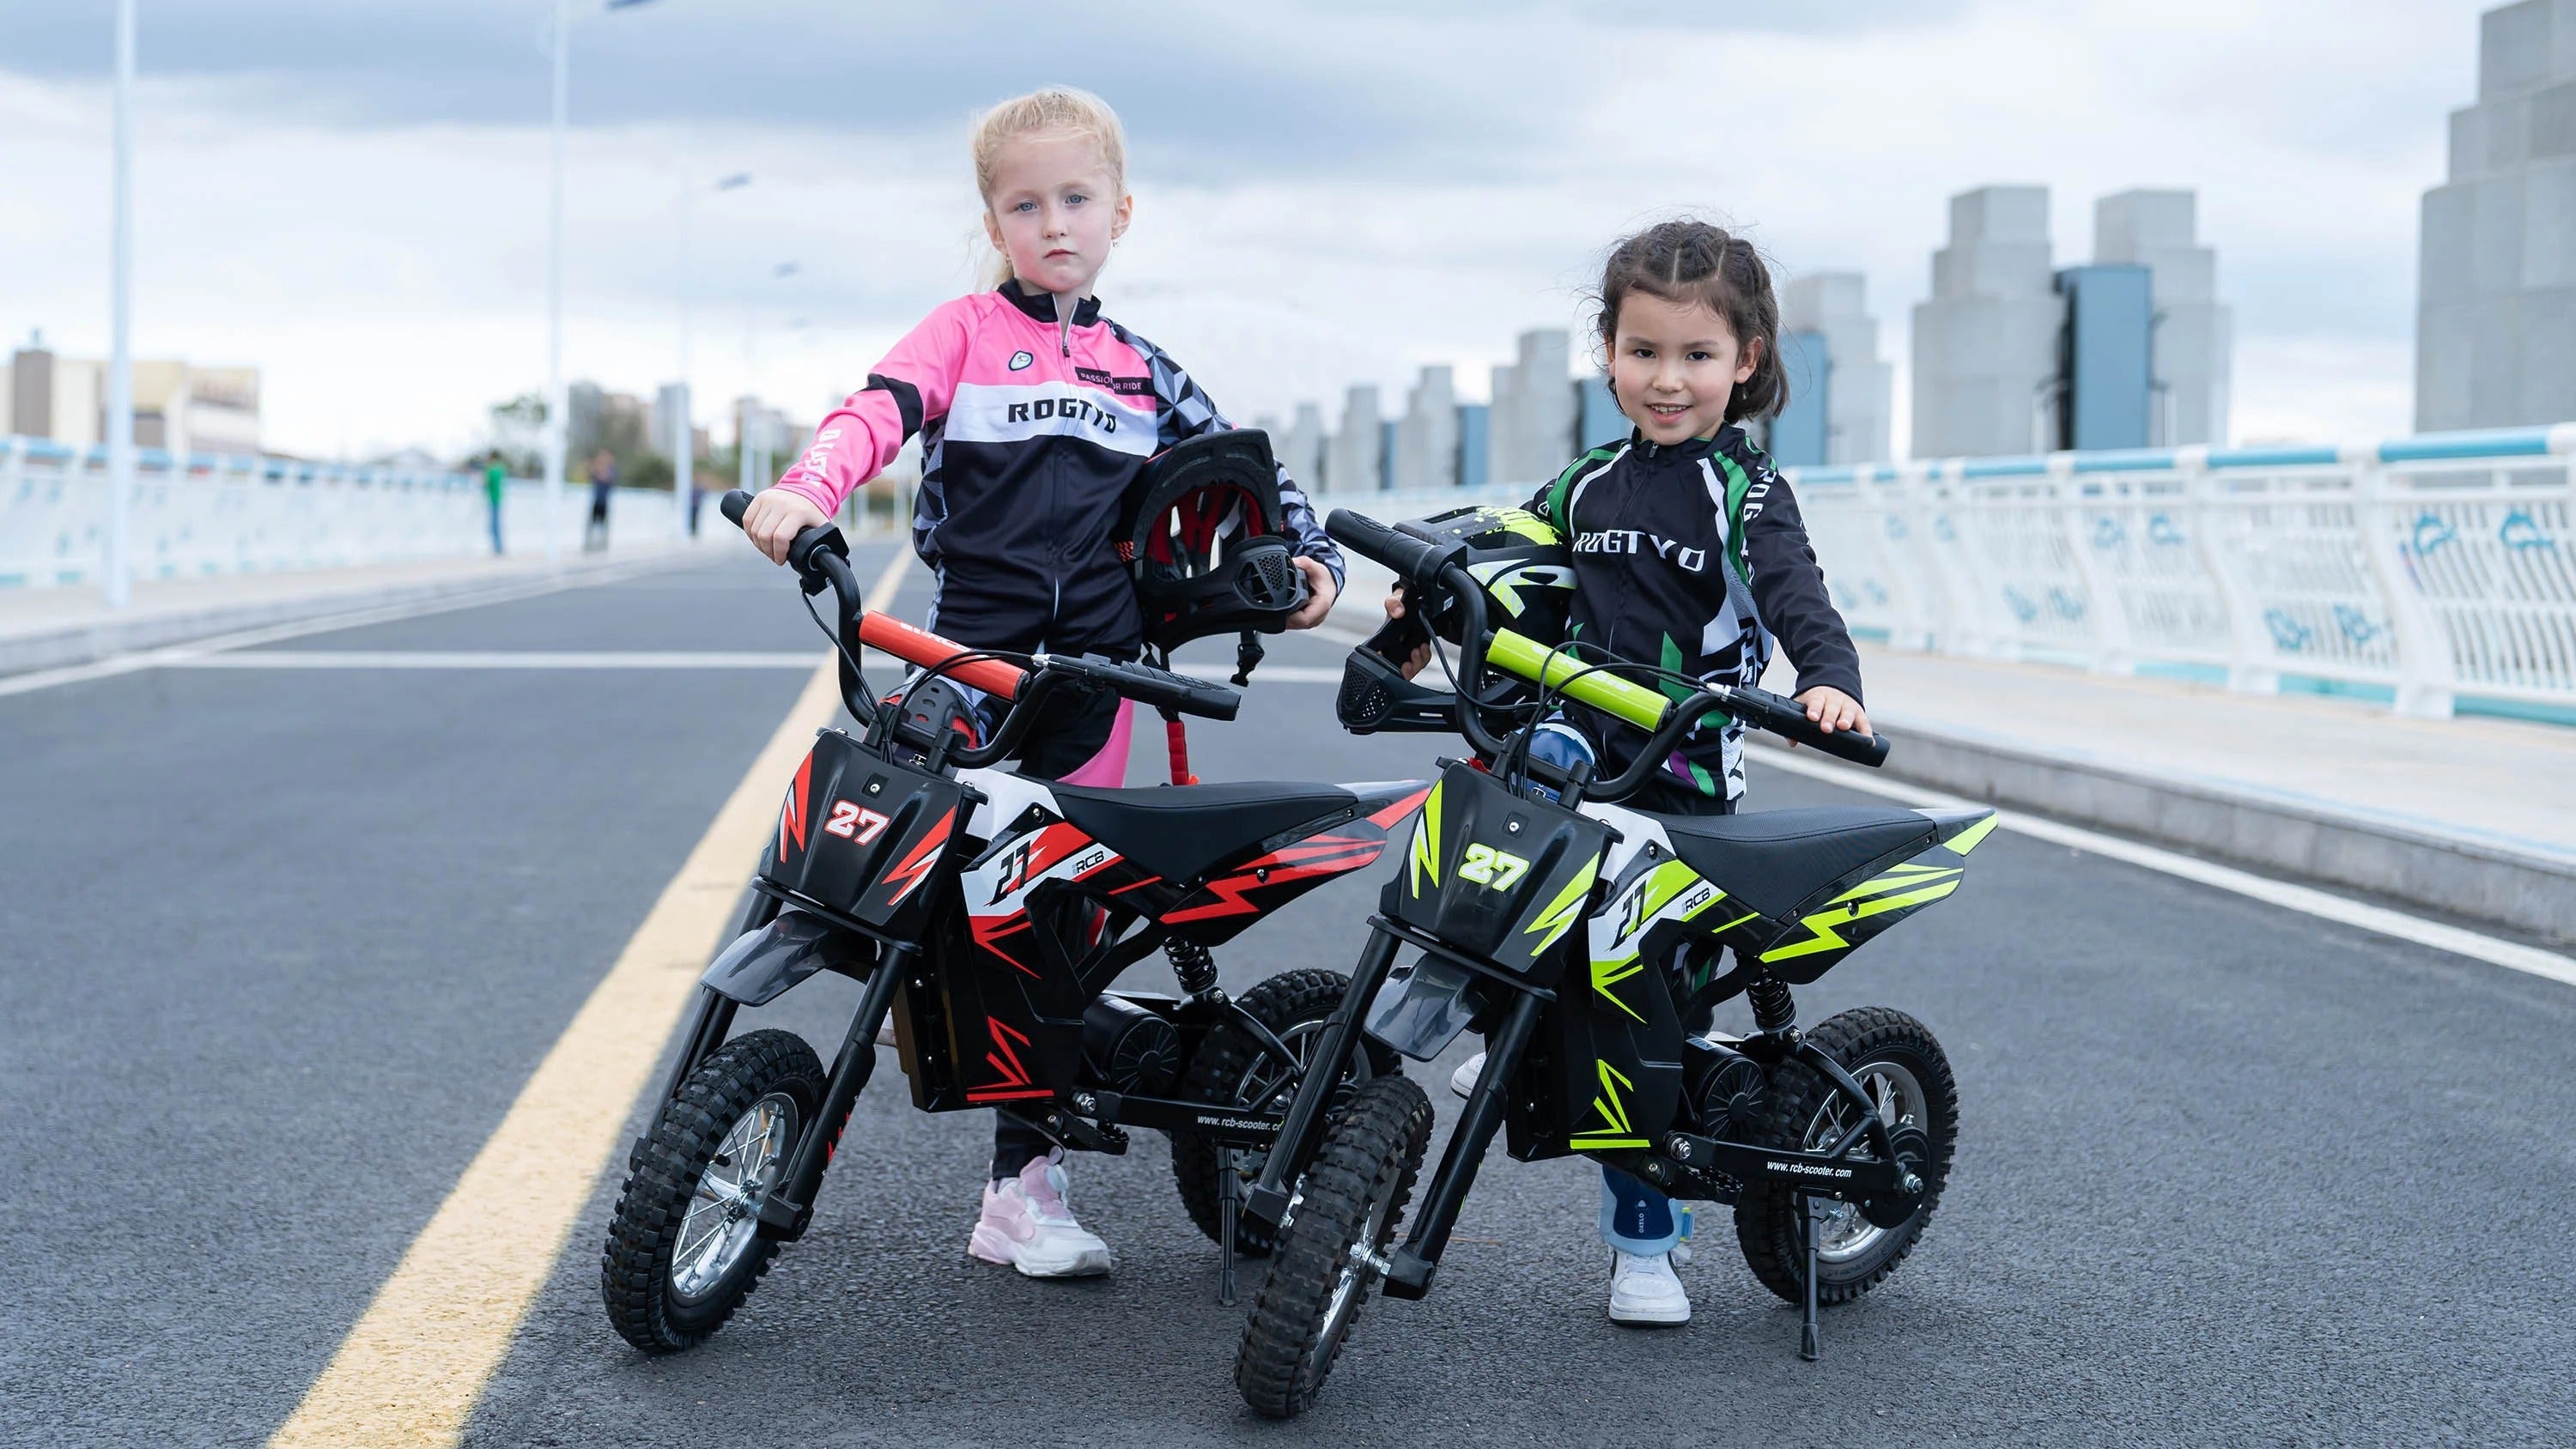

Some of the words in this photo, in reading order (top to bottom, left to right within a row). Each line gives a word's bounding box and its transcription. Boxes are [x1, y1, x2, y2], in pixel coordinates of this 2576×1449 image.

[1080, 373, 1113, 384] PASSIO
[1572, 530, 1704, 572] ROGTYO
[824, 800, 890, 846] 27
[1075, 851, 1104, 873] RCB
[1458, 842, 1530, 892] 27
[1685, 888, 1710, 912] RCB
